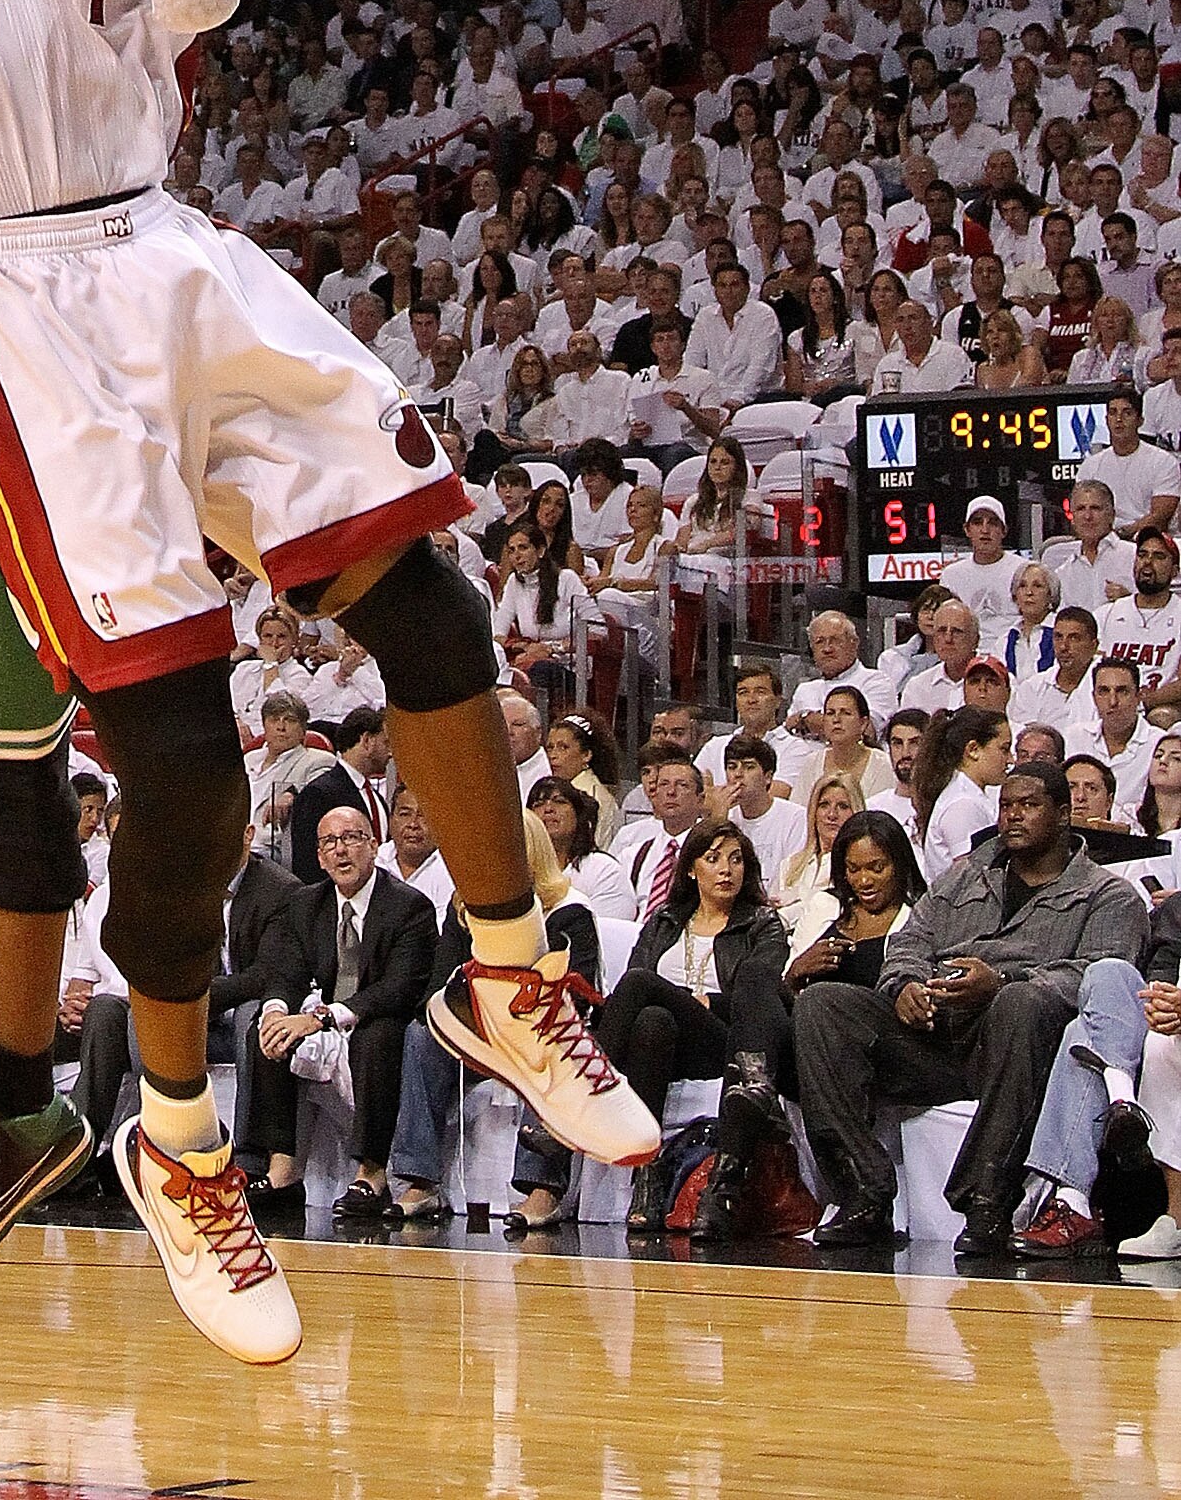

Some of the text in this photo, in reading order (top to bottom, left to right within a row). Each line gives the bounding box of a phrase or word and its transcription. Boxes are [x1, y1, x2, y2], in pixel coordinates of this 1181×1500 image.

[961, 336, 982, 352] HE
[950, 406, 1052, 450] 9:45
[879, 471, 914, 489] HEAT
[884, 499, 936, 545] 51
[1111, 638, 1177, 667] HEAT
